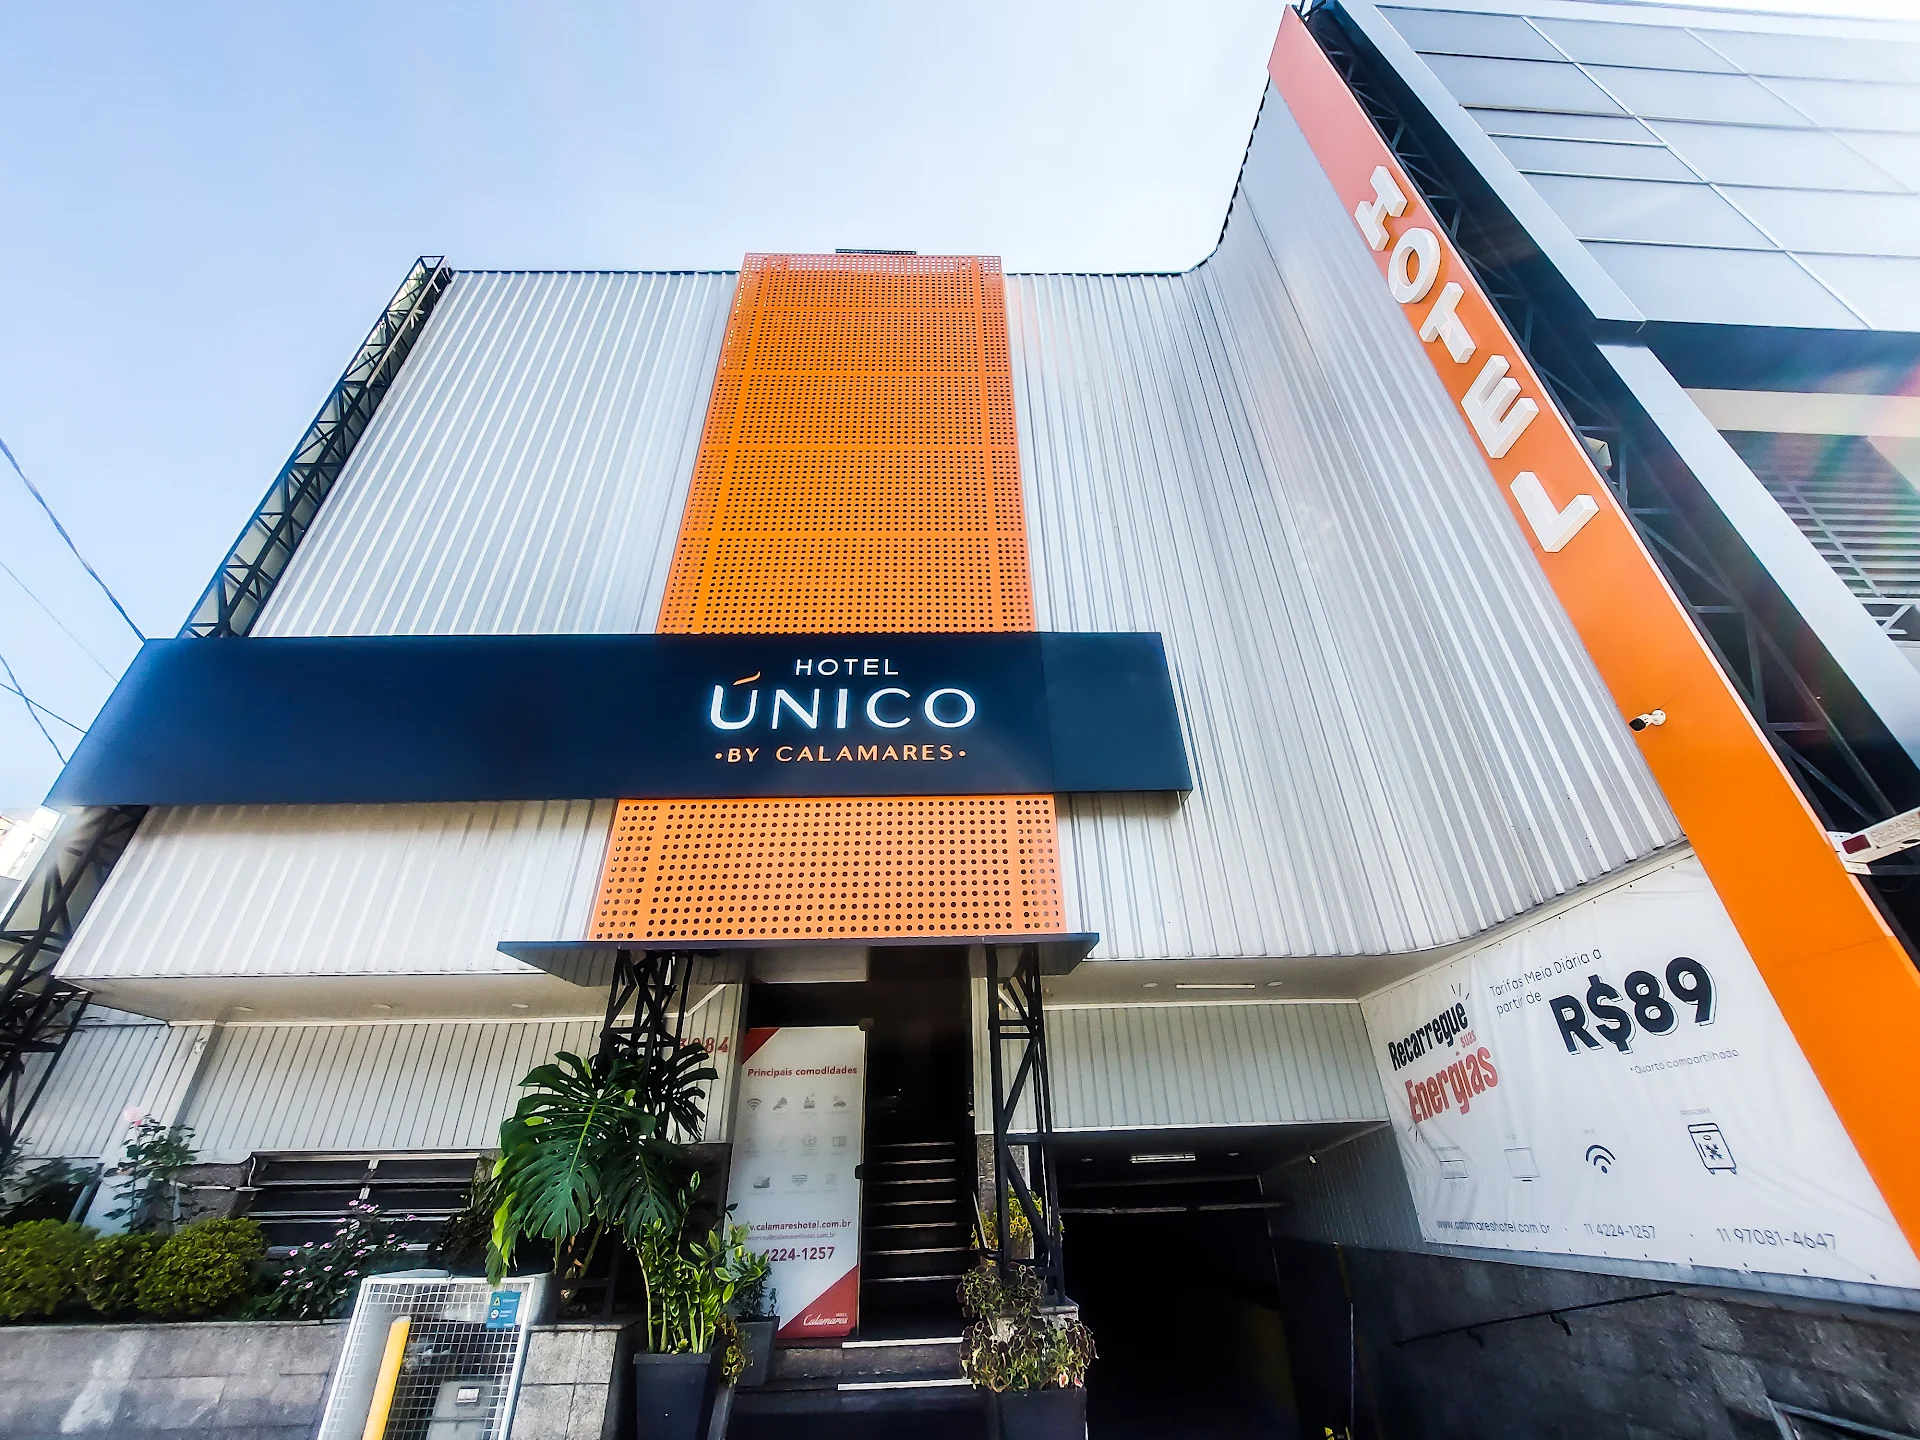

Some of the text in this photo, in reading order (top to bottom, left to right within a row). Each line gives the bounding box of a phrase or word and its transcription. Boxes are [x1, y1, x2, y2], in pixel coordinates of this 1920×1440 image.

[1354, 165, 1600, 552] HOTEL
[795, 658, 899, 676] HOTEL
[710, 671, 976, 730] ÚNICO
[1489, 948, 1602, 998] Tarifas Meia Diária a
[1496, 991, 1542, 1018] partir de
[1549, 957, 1717, 1056] R$89
[1387, 1002, 1468, 1072] Recarregue
[1459, 1029, 1477, 1049] suas
[1666, 1048, 1739, 1069] compartilhado
[747, 1065, 858, 1079] Principais comodidades
[1404, 1047, 1498, 1124] Energias
[1436, 1219, 1550, 1235] www.calamareshotel.com.br
[1584, 1223, 1656, 1240] 11 4224-1257
[1716, 1227, 1836, 1250] 11 97081-4647
[803, 1312, 849, 1326] Calamares
